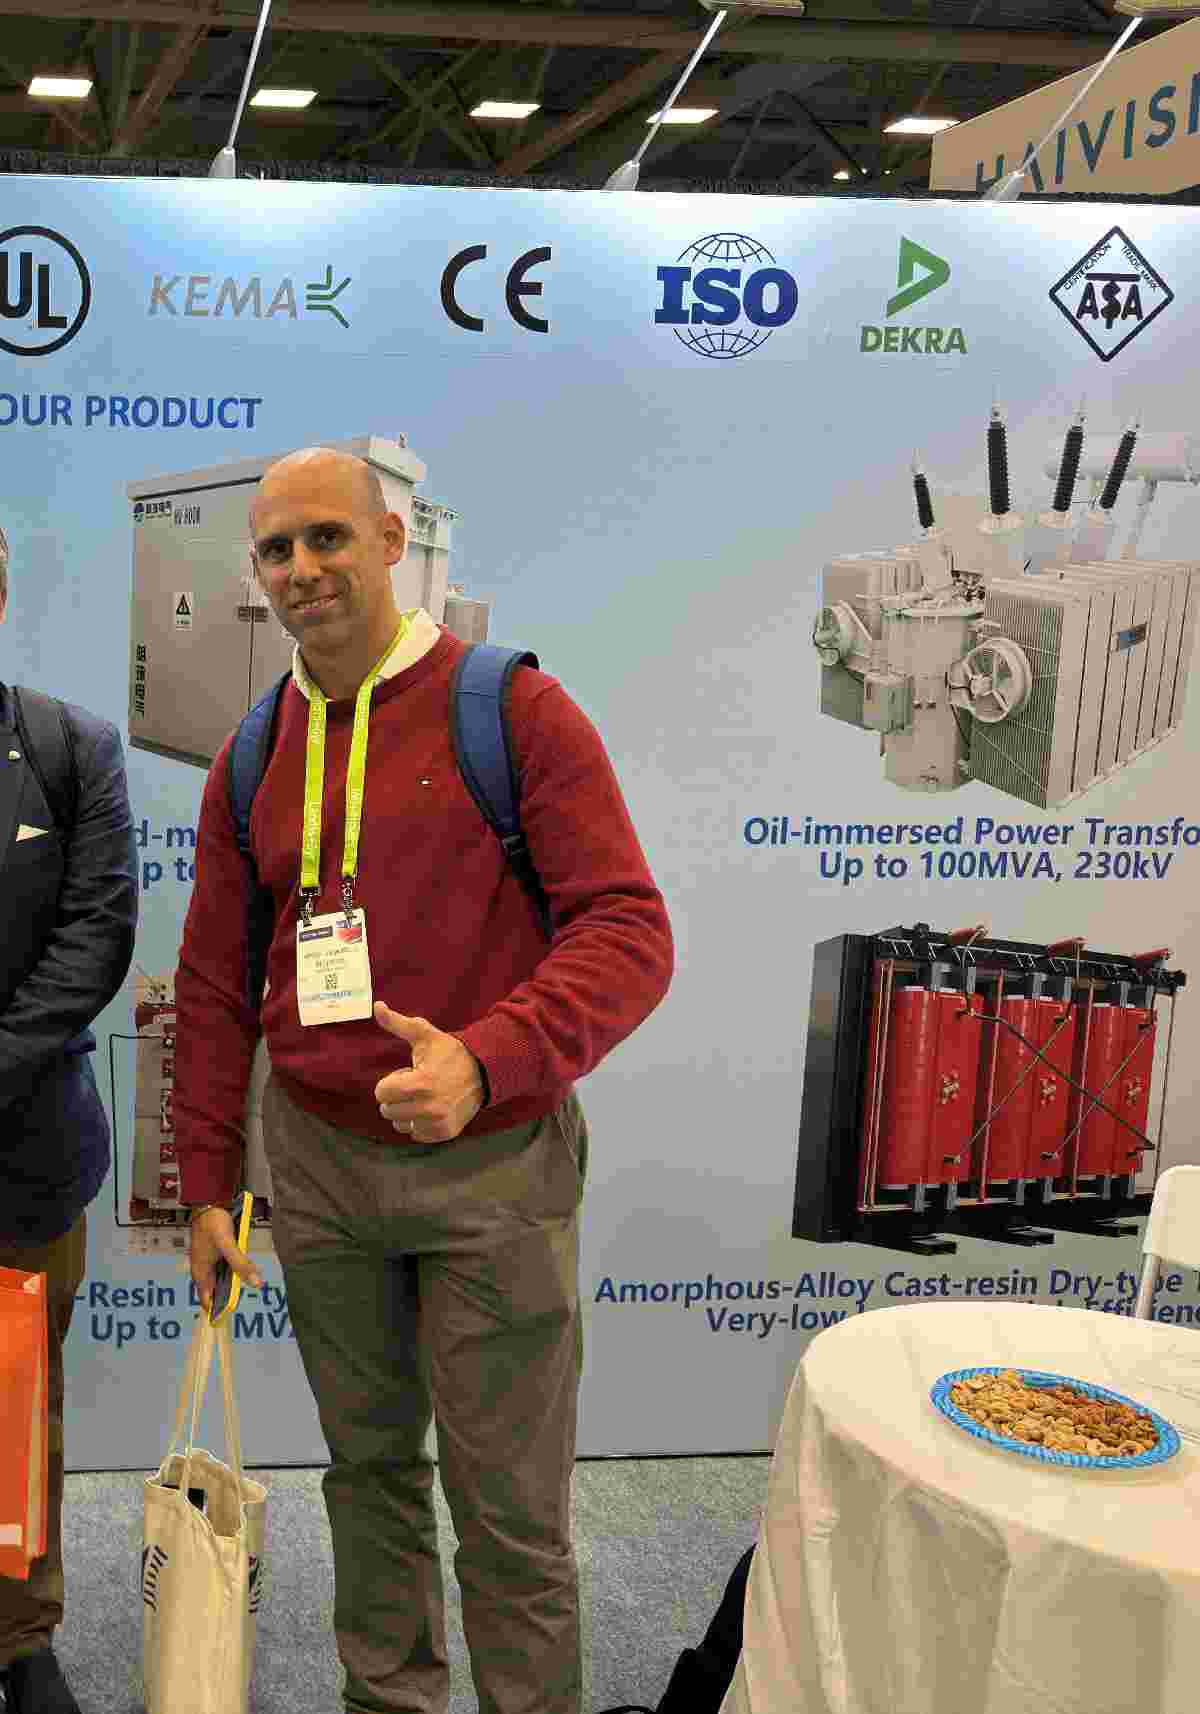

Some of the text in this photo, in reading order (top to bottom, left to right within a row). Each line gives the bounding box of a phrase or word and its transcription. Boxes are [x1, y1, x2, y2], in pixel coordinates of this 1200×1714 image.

[147, 274, 298, 320] KEMA
[440, 244, 551, 333] CE
[655, 265, 798, 328] ISO
[860, 326, 968, 354] DEKRA
[85, 395, 263, 429] PRODUCT
[743, 816, 963, 845] Oil-immersed
[975, 817, 1074, 845] Power
[819, 851, 1174, 886] Up to 100MVA, 230kV
[595, 1271, 875, 1309] Amorphous-Alloy
[885, 1270, 1038, 1297] Cast-resin
[91, 1313, 137, 1348] Up
[149, 1316, 181, 1341] to
[706, 1305, 848, 1338] Very-low
